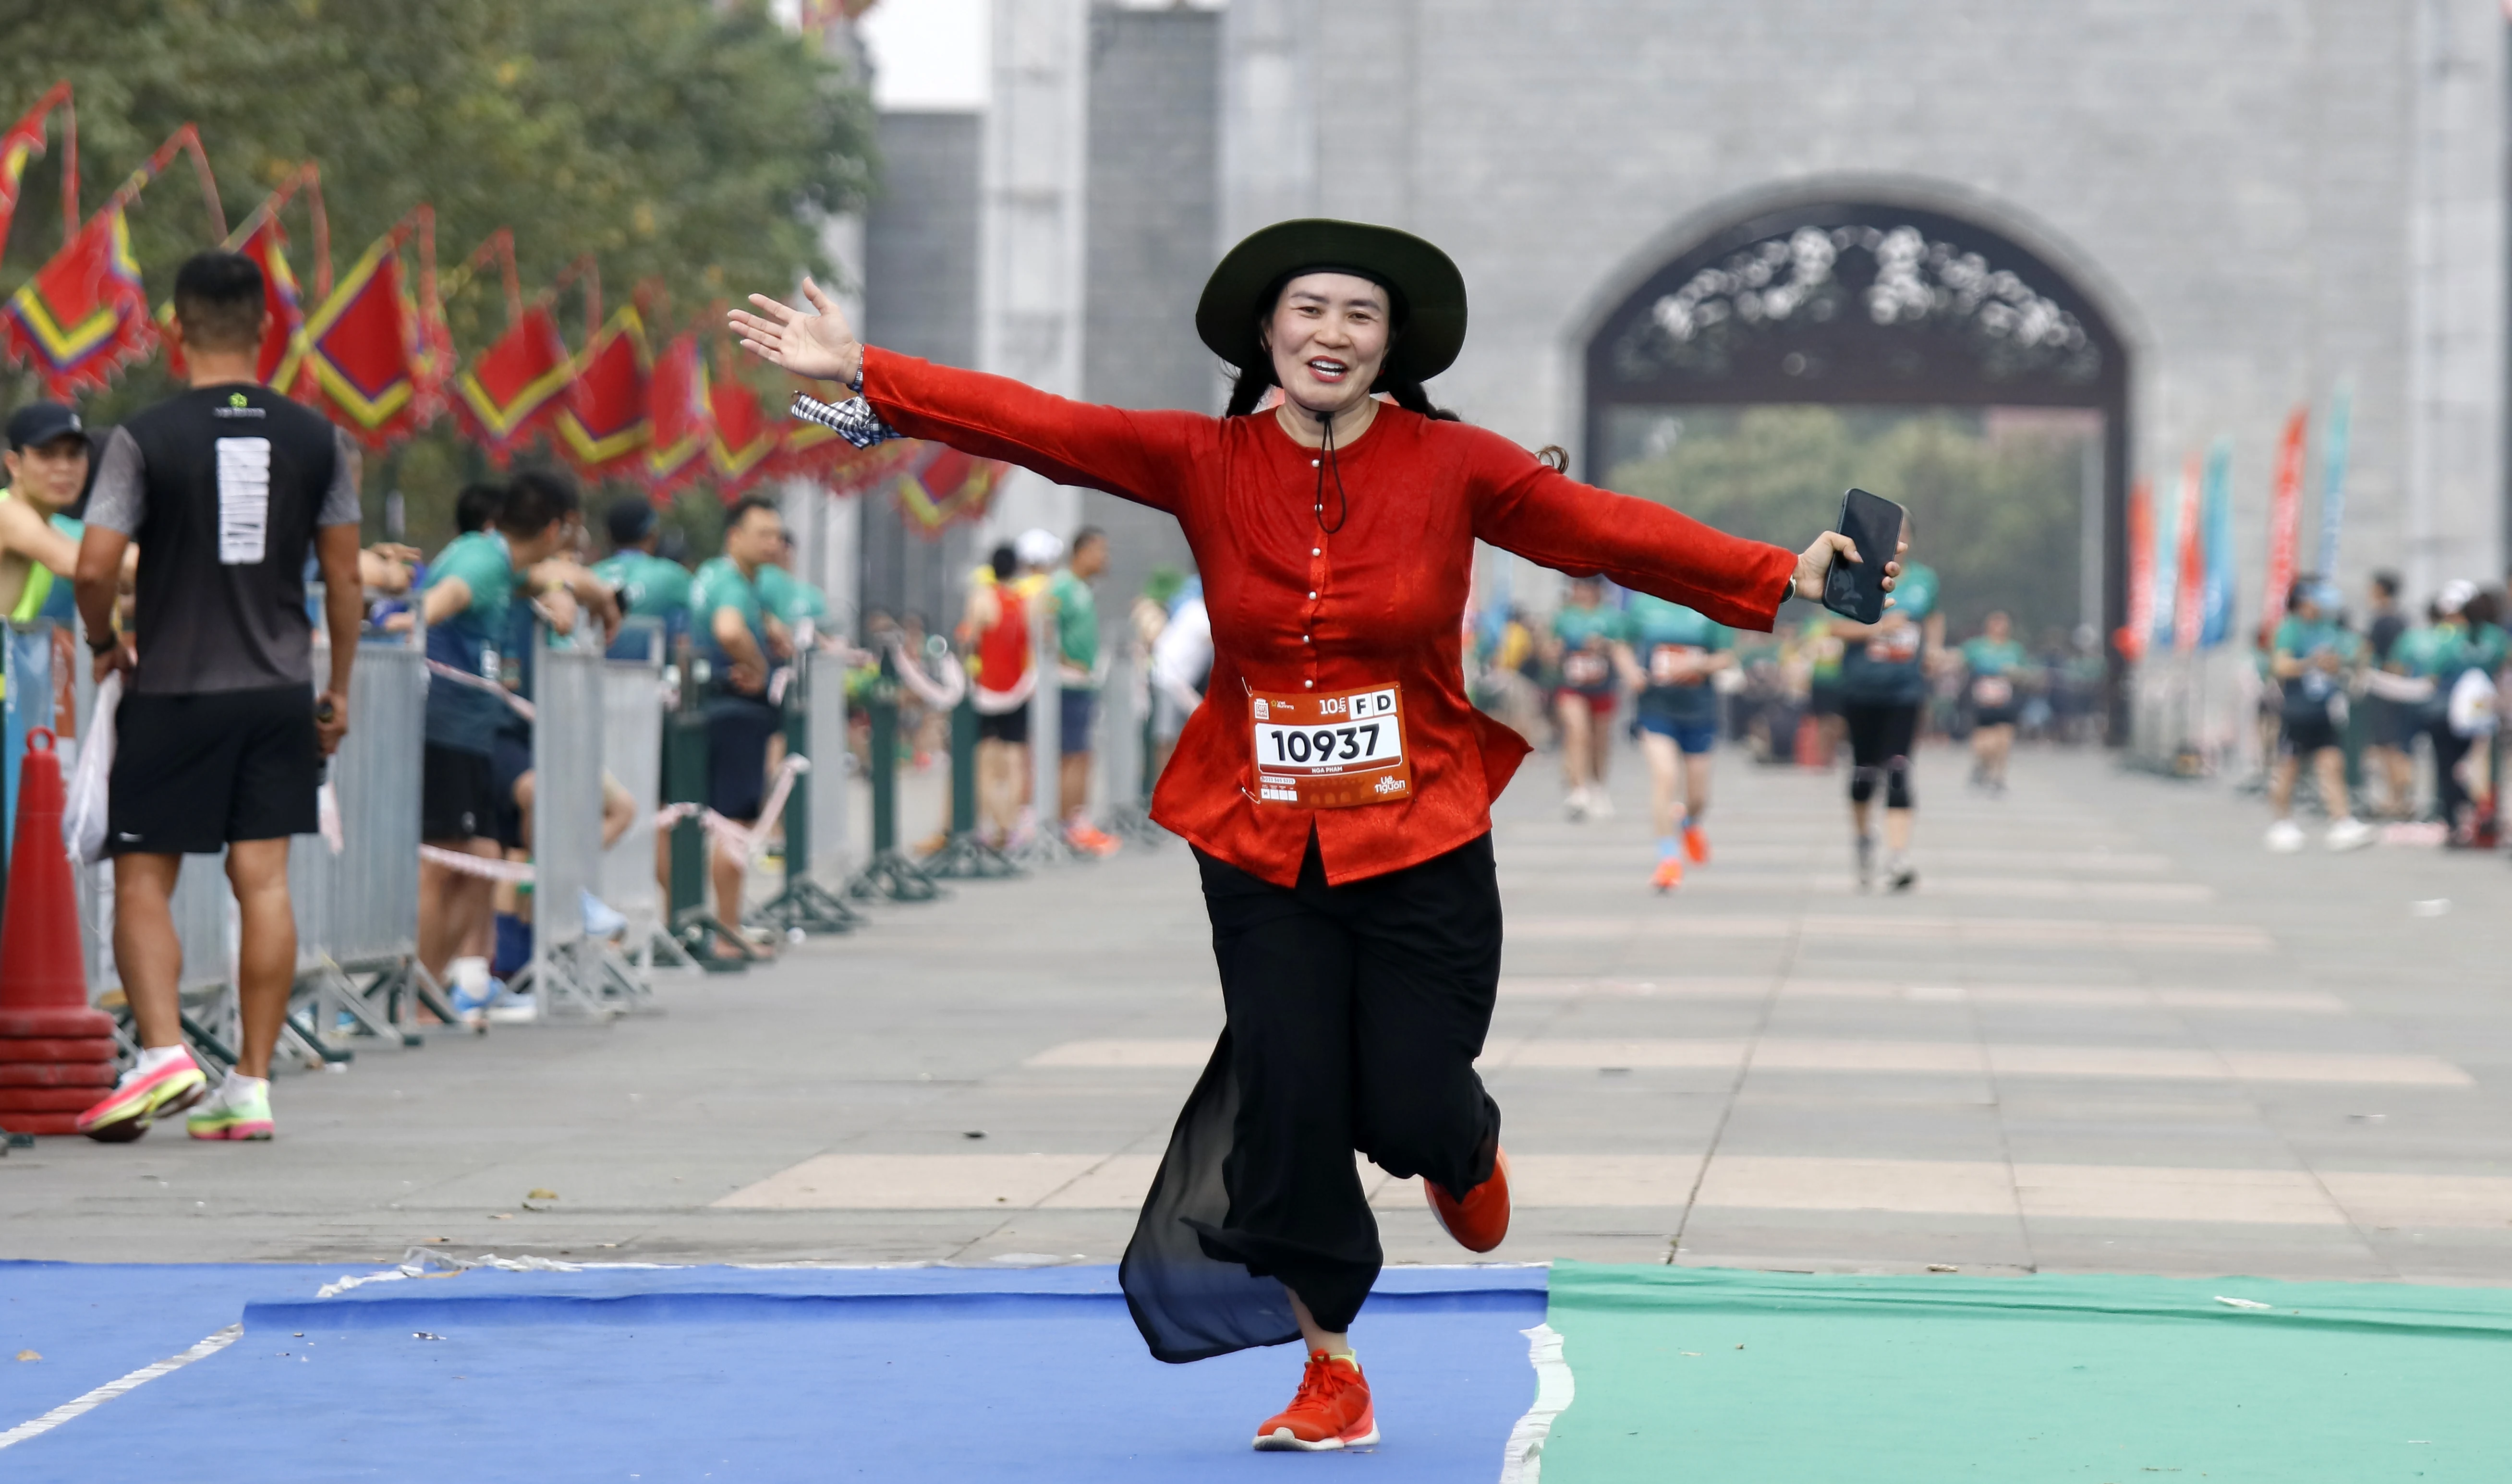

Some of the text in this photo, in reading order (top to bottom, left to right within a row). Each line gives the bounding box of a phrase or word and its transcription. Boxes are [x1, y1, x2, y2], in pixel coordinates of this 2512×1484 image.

[1319, 697, 1347, 714] 10 km
[1356, 698, 1366, 714] F
[1377, 695, 1391, 711] D
[1271, 723, 1380, 762] 10937
